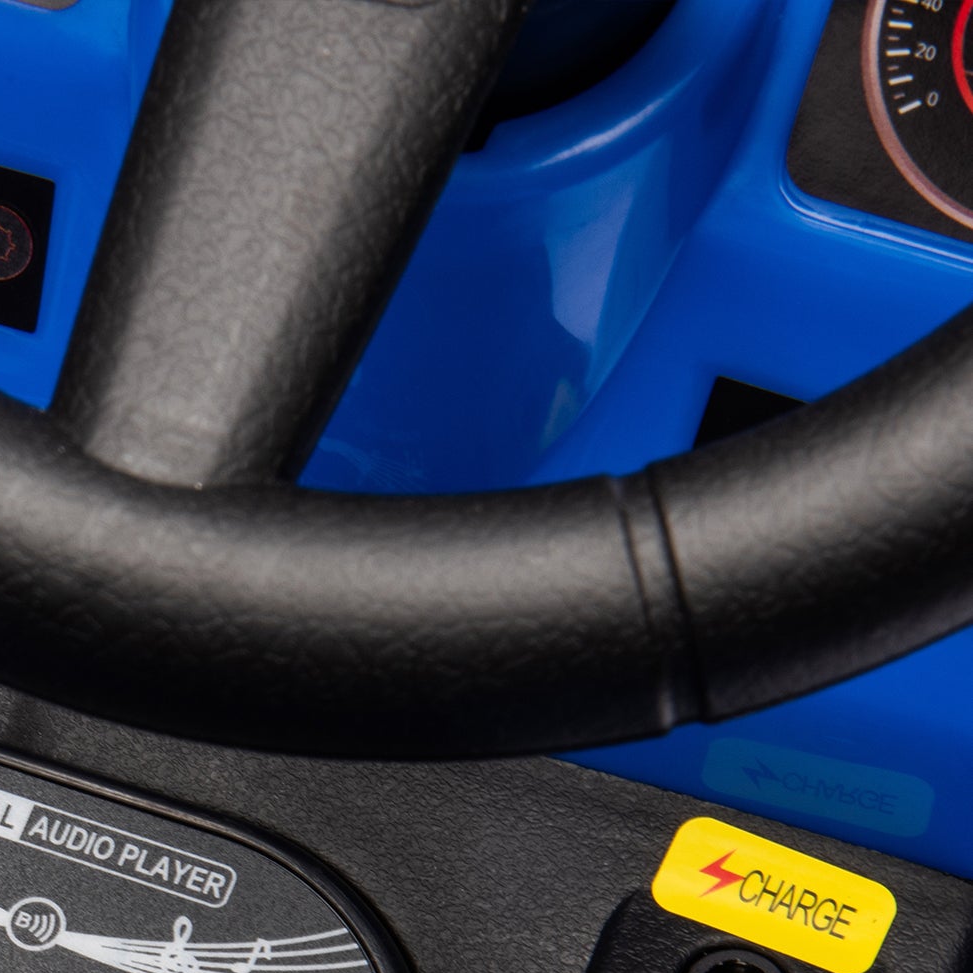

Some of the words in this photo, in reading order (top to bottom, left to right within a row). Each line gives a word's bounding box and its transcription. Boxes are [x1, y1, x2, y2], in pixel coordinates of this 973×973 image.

[915, 43, 937, 61] 20
[927, 91, 939, 107] 0
[27, 816, 116, 860] AUDIO
[117, 843, 227, 899] PLAYER
[738, 869, 858, 940] CHARGE
